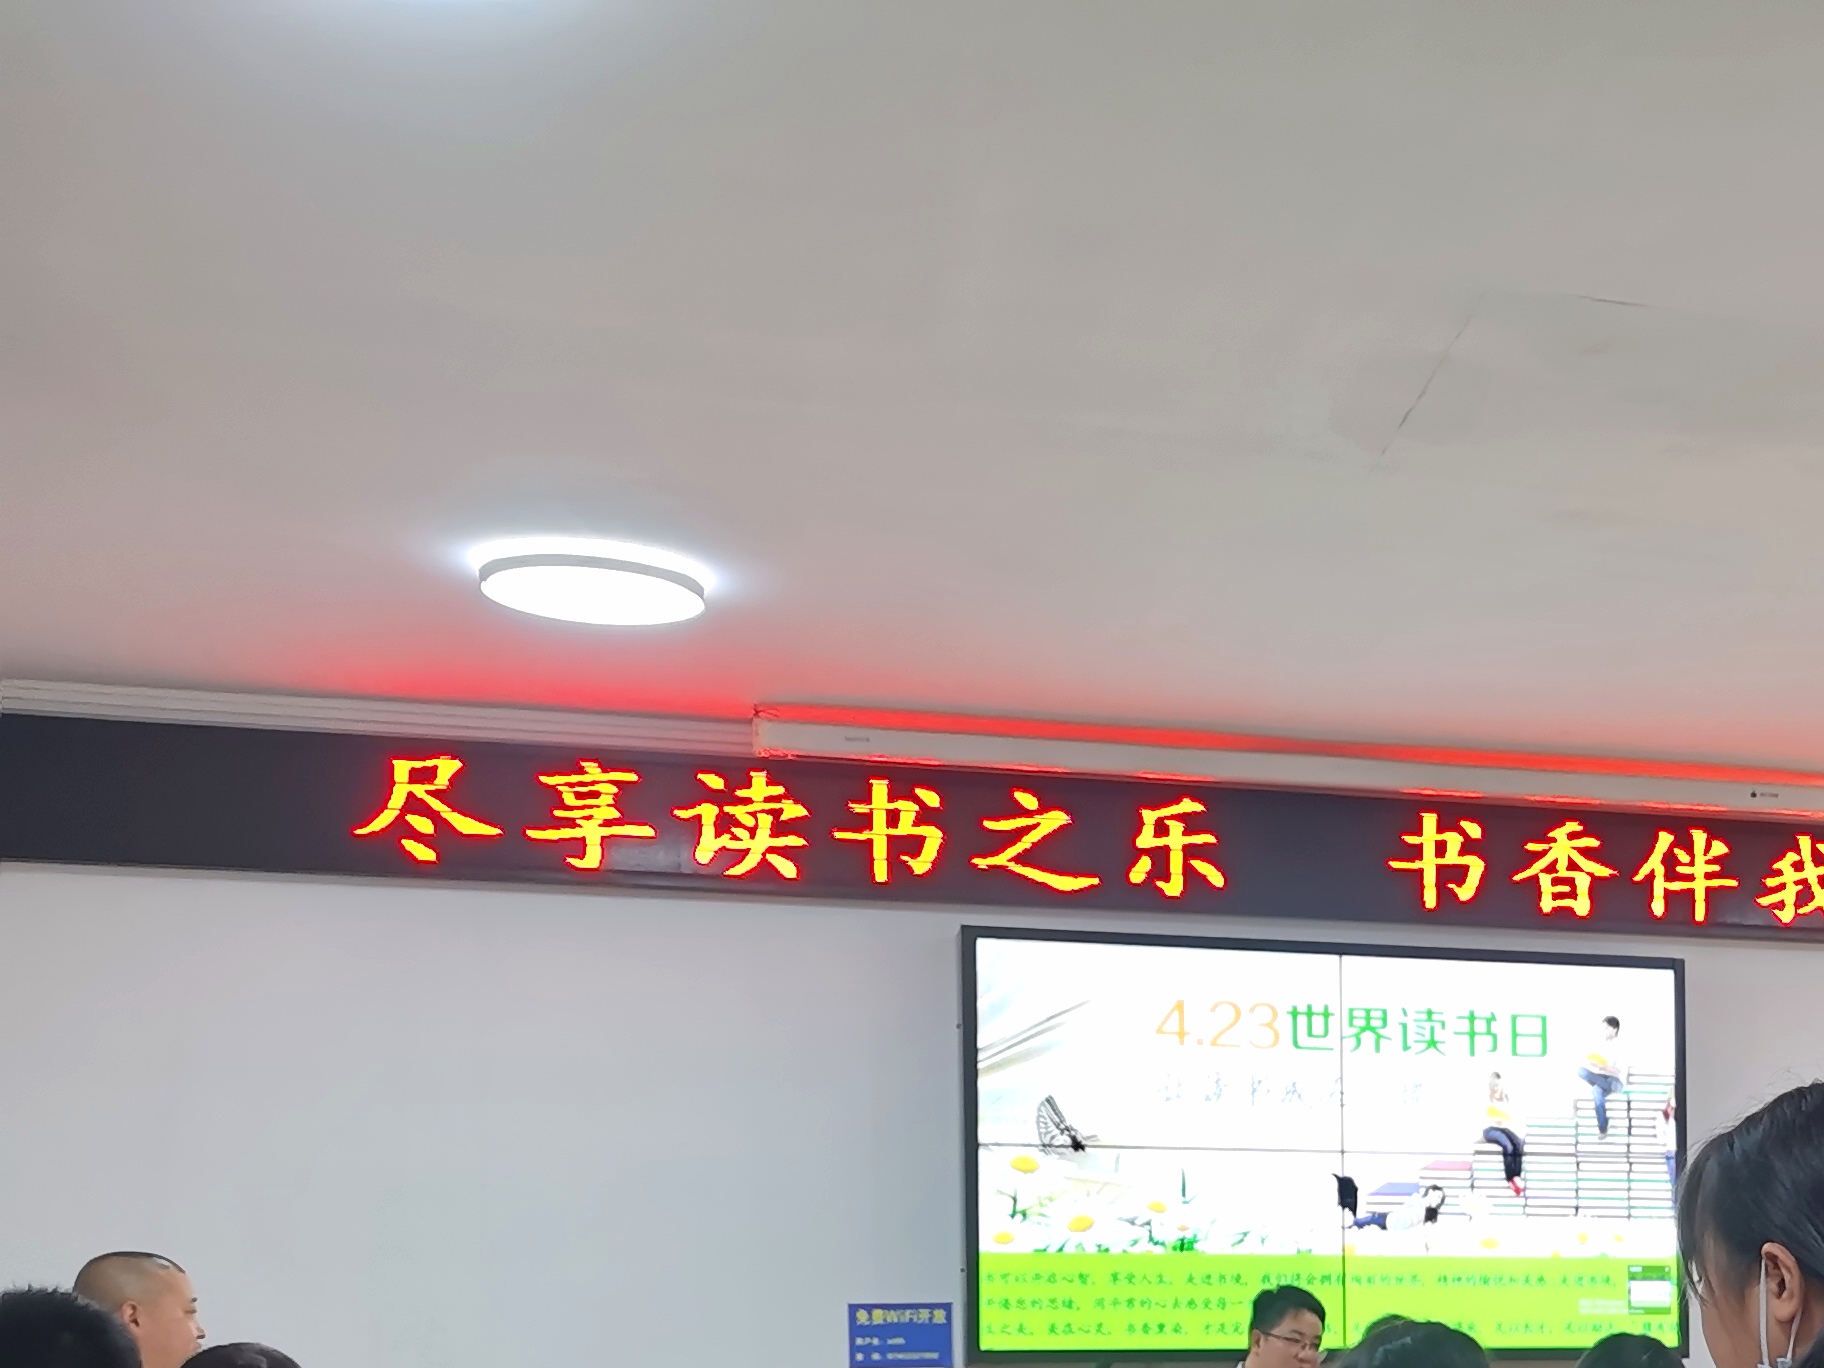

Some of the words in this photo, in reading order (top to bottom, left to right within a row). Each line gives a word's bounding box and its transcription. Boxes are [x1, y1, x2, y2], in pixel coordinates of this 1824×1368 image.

[352, 754, 1228, 898] 尽享读书之乐
[1155, 999, 1548, 1058] 4.23世界读书日
